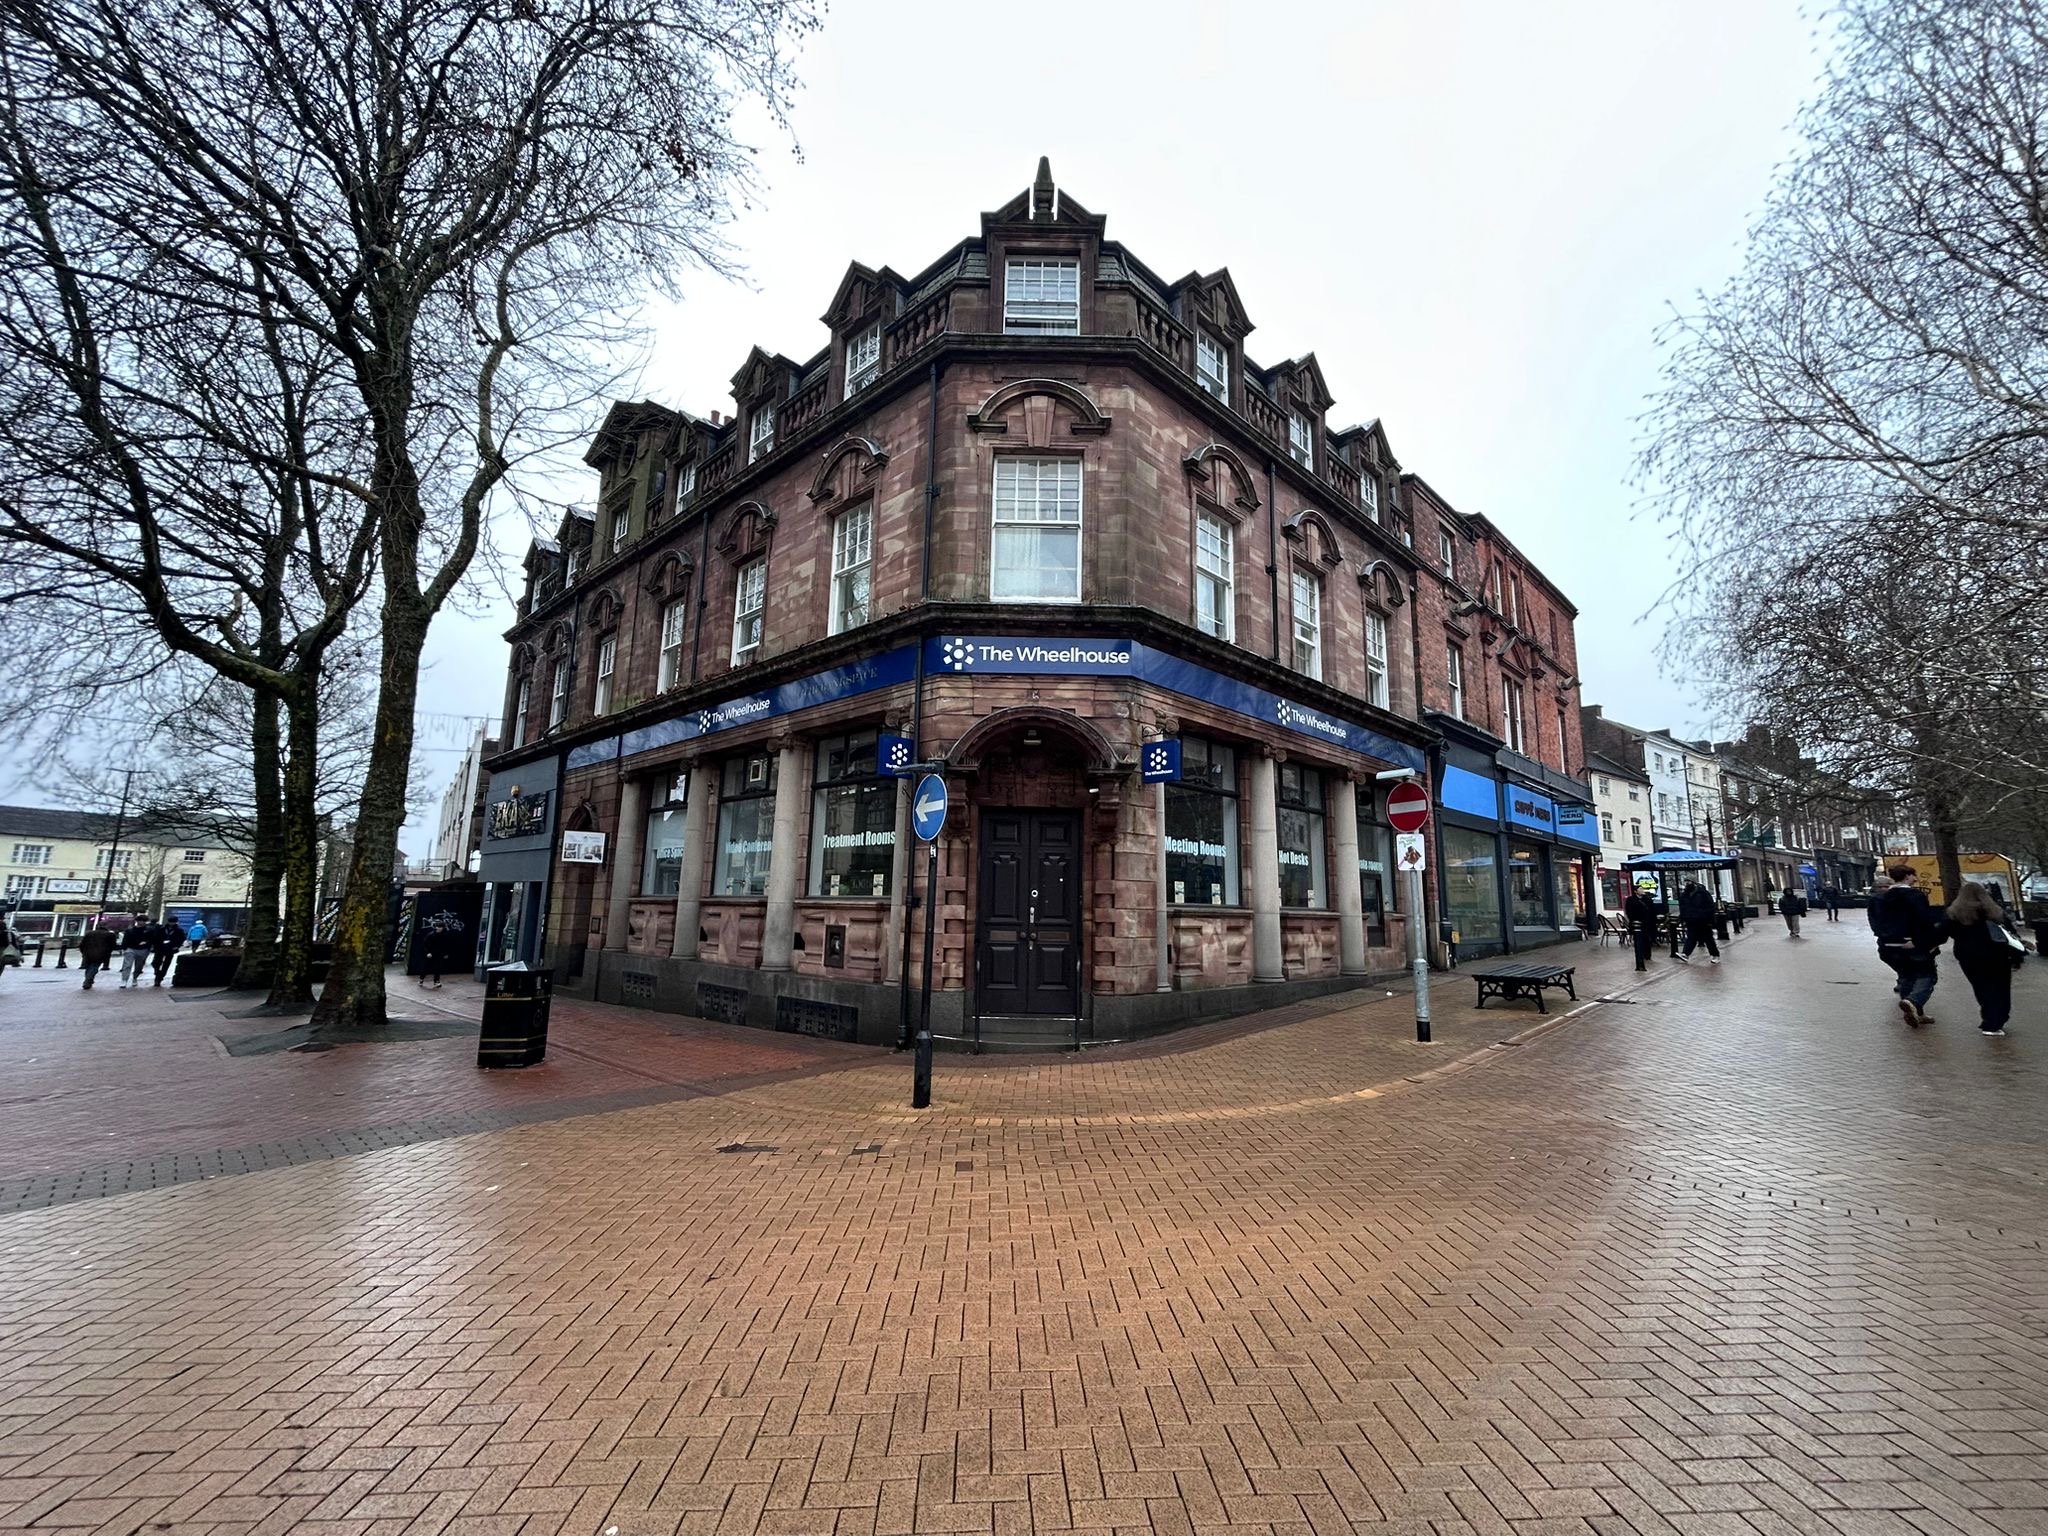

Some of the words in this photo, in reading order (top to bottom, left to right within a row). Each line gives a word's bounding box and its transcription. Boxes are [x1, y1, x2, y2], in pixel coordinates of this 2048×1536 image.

[979, 646, 1013, 661] The
[1016, 646, 1130, 664] Wheelhouse
[711, 712, 725, 724] The
[725, 699, 770, 720] Wheelhouse
[1291, 708, 1306, 725] The
[1305, 713, 1347, 739] Wheelhouse
[743, 840, 772, 853] Conferen
[823, 832, 864, 849] Treatment
[865, 831, 896, 846] Rooms
[1165, 836, 1199, 856] Meeting
[1200, 840, 1227, 858] Rooms
[1279, 850, 1290, 864] Hot
[1290, 851, 1309, 867] Desks
